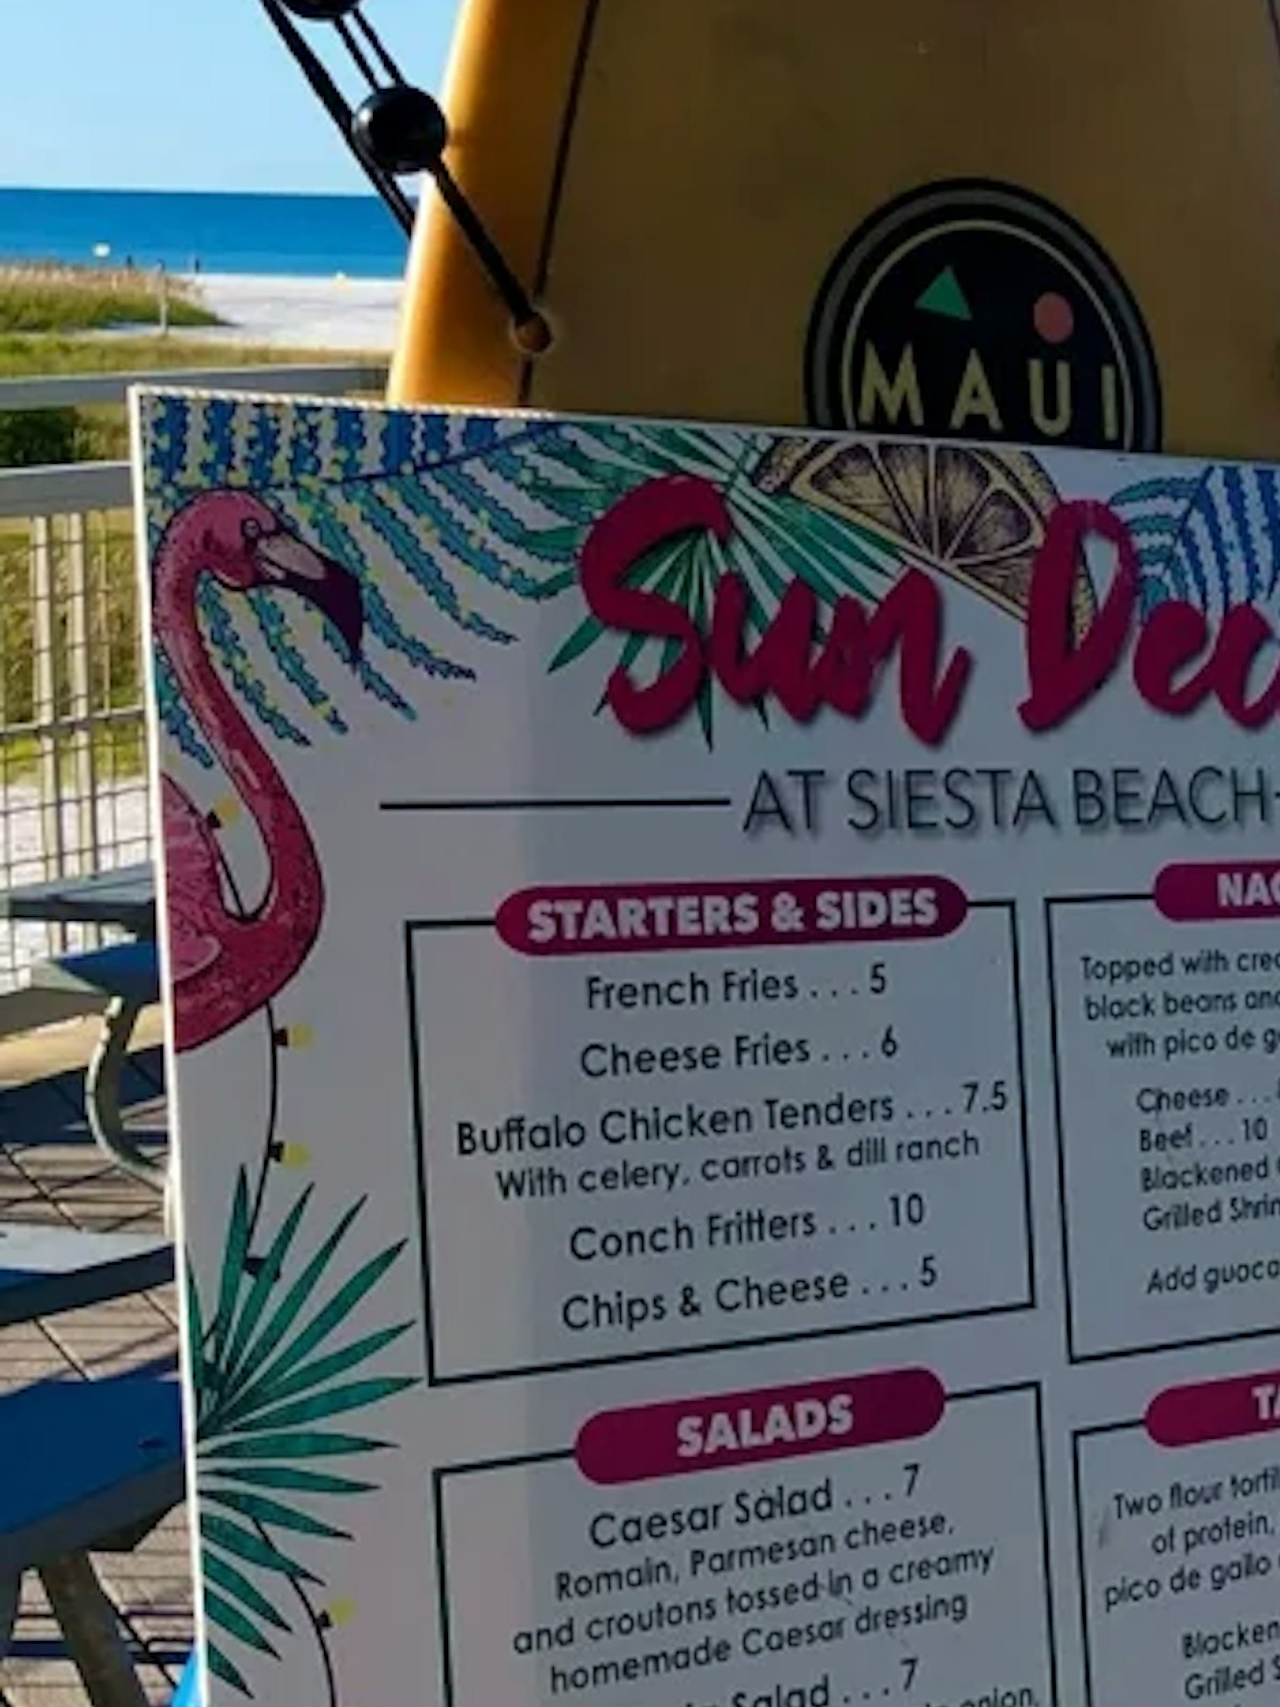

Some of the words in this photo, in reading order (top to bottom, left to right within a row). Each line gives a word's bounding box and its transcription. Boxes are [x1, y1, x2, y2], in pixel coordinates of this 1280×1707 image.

[858, 338, 1119, 441] MAUI
[578, 474, 972, 746] Sun
[742, 769, 826, 835] AT
[847, 769, 1057, 834] SIESTA
[1073, 766, 1271, 827] BEACH
[528, 894, 758, 942] STARTERS
[772, 892, 803, 931] &
[817, 888, 937, 929] SIDES
[585, 971, 709, 1010] French
[722, 968, 799, 1002] Fries
[870, 961, 887, 995] 5
[1080, 951, 1174, 986] Topped
[1180, 949, 1230, 975] with
[580, 1042, 722, 1079] Cheese
[734, 1031, 810, 1068] Fries
[881, 1024, 899, 1058] 6
[457, 1114, 587, 1157] Buffalo
[600, 1103, 753, 1145] Chicken
[763, 1092, 894, 1130] Tenders
[961, 1080, 1009, 1114] 7.5
[1136, 1087, 1230, 1118] Cheese
[1139, 1122, 1192, 1153] Beef
[1242, 1115, 1268, 1142] 10
[495, 1166, 567, 1200] With
[577, 1159, 690, 1193] celery,
[700, 1145, 806, 1182] carrots
[816, 1144, 836, 1171] &
[846, 1136, 887, 1167] dill
[896, 1129, 980, 1163] ranch
[1140, 1154, 1269, 1193] Blackened
[569, 1216, 694, 1261] Conch
[706, 1208, 817, 1248] Fritters
[889, 1192, 925, 1227] 10
[1142, 1199, 1222, 1232] Grilled
[562, 1290, 668, 1332] Chips
[678, 1284, 702, 1318] &
[715, 1272, 850, 1313] Cheese
[919, 1254, 937, 1288] 5
[1146, 1264, 1197, 1295] Add
[677, 1394, 853, 1457] SALADS
[588, 1502, 724, 1550] Caesar
[735, 1476, 833, 1526] Salad
[903, 1462, 920, 1497] 7
[690, 1533, 836, 1577] Parmesan
[512, 1616, 575, 1655] and
[585, 1598, 717, 1642] croutons
[725, 1571, 819, 1616] tossed
[828, 1568, 853, 1597] in
[862, 1567, 880, 1590] a
[888, 1546, 994, 1585] creamy
[550, 1635, 732, 1695] homemade
[741, 1617, 846, 1657] Caesar
[854, 1594, 968, 1636] dressing
[900, 1656, 919, 1692] 7
[1184, 1659, 1265, 1700] Grilled
